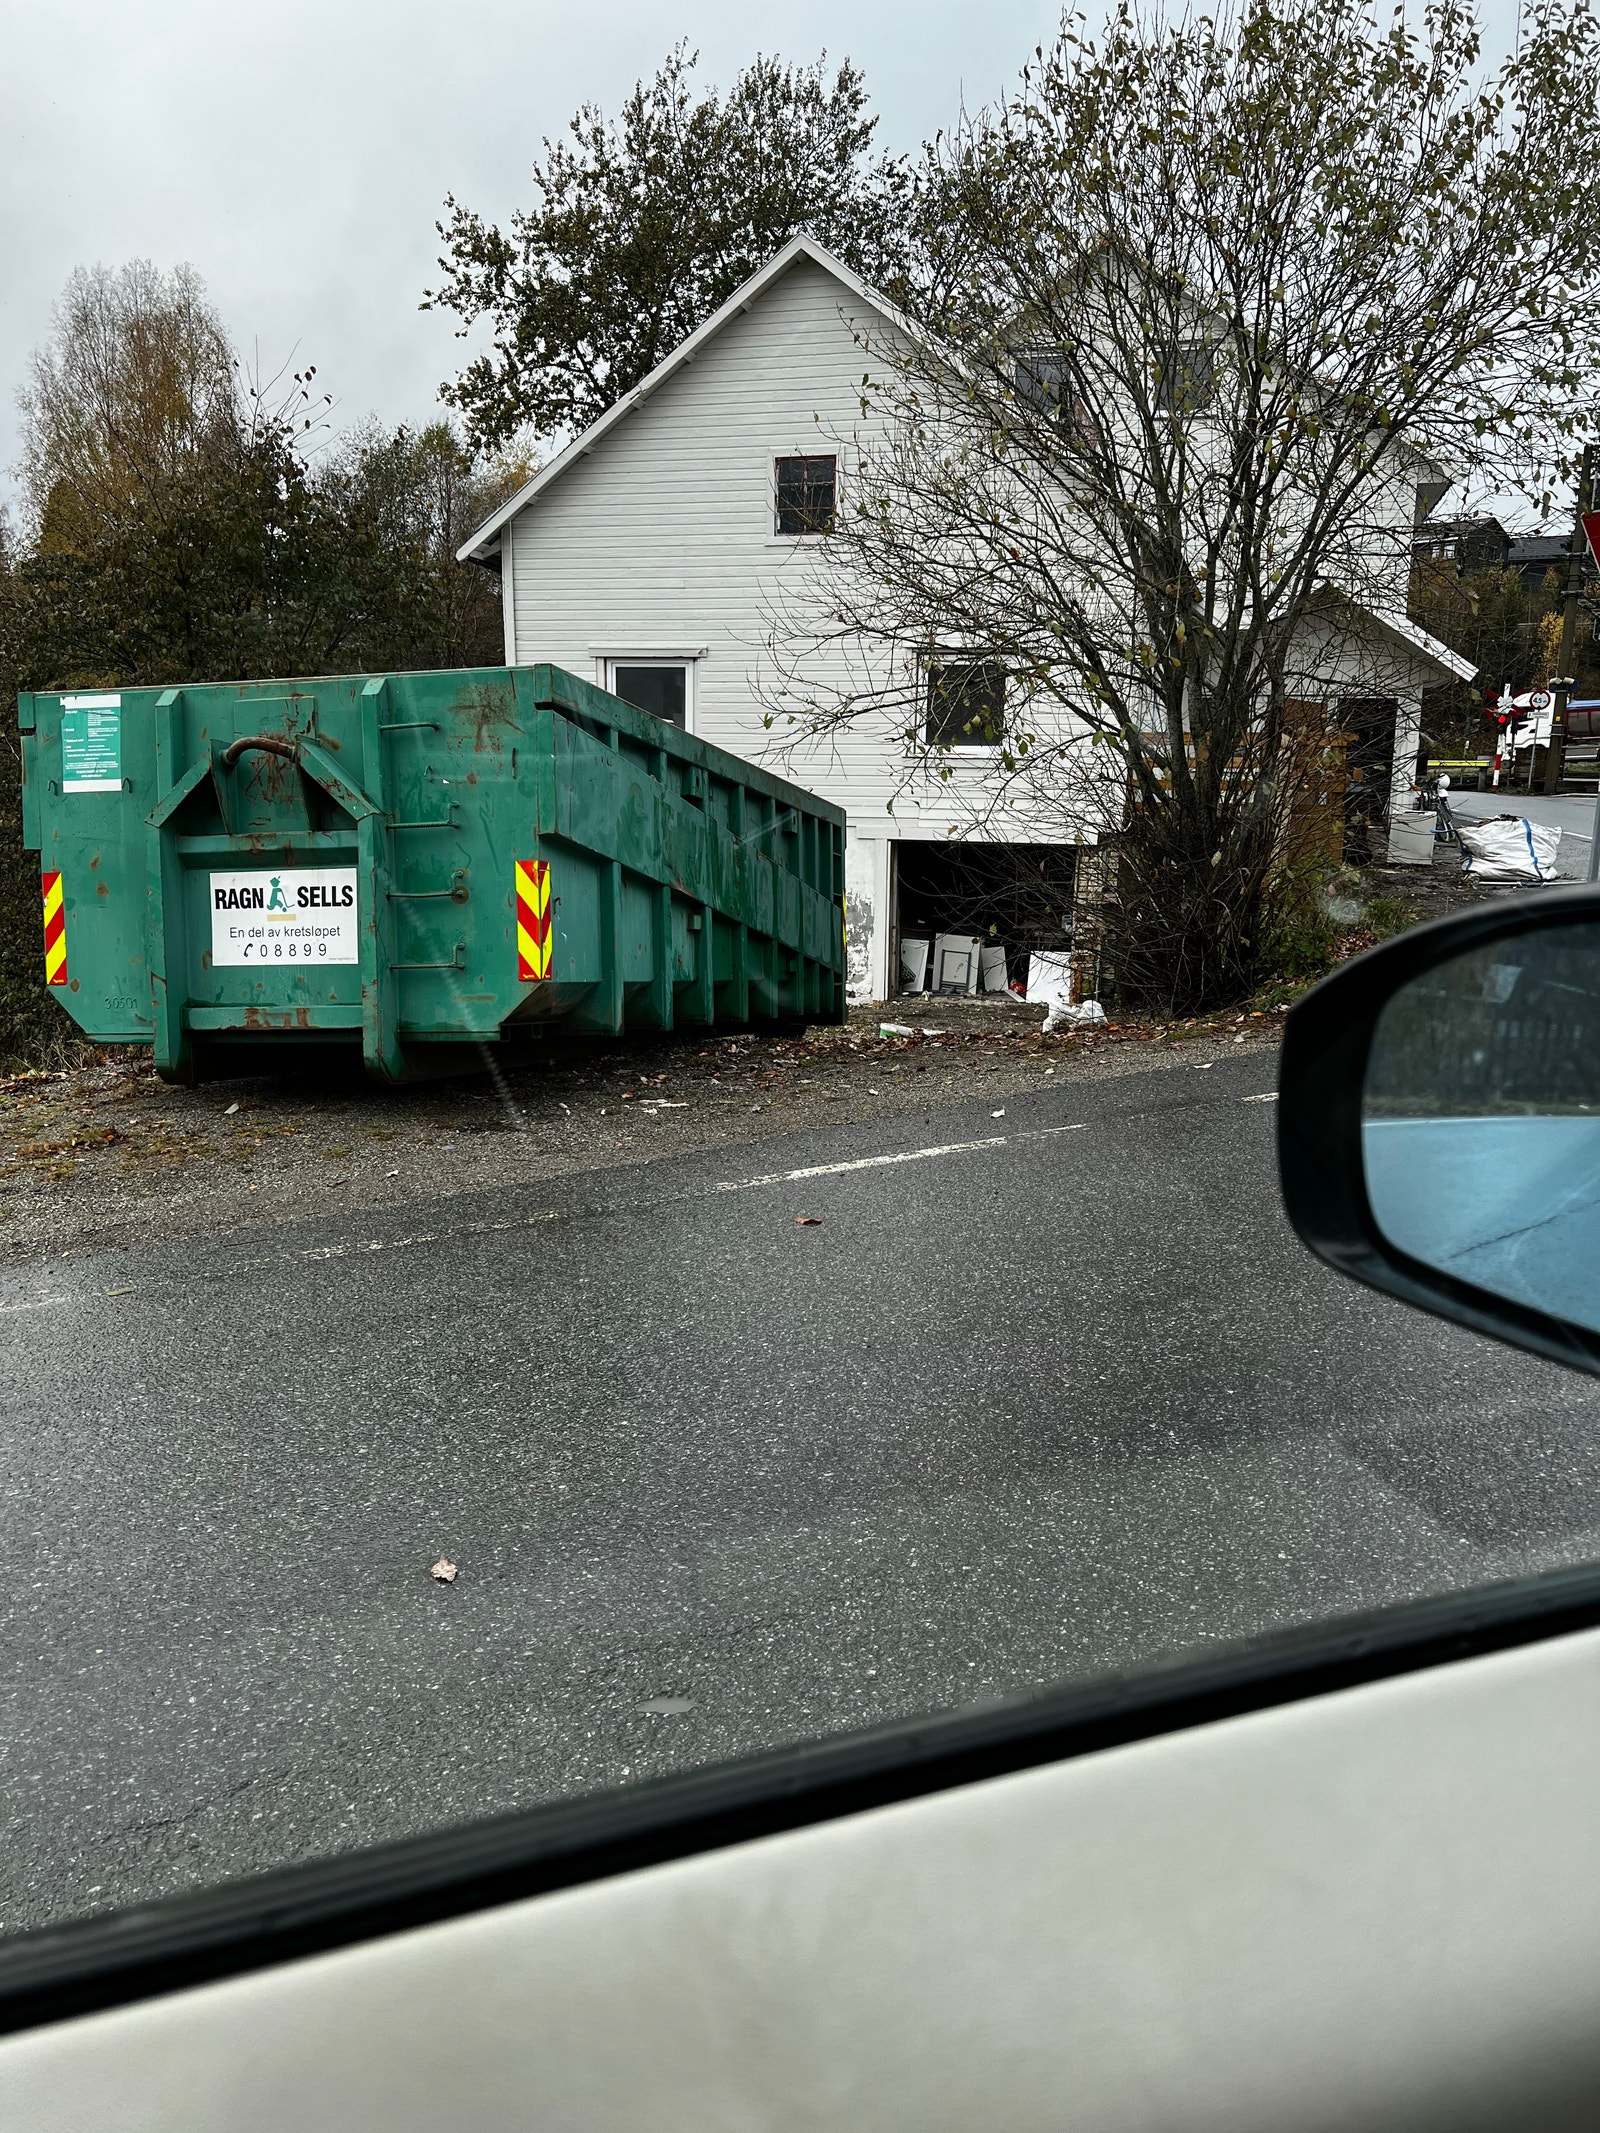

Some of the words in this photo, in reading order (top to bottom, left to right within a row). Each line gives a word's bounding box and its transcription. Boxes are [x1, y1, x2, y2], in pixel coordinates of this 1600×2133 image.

[215, 887, 264, 910] RAGN
[297, 885, 353, 908] SELLS
[230, 927, 244, 938] En
[248, 926, 264, 938] del
[268, 928, 280, 937] av
[284, 926, 341, 939] kretsløpet
[105, 996, 137, 1009] 30501
